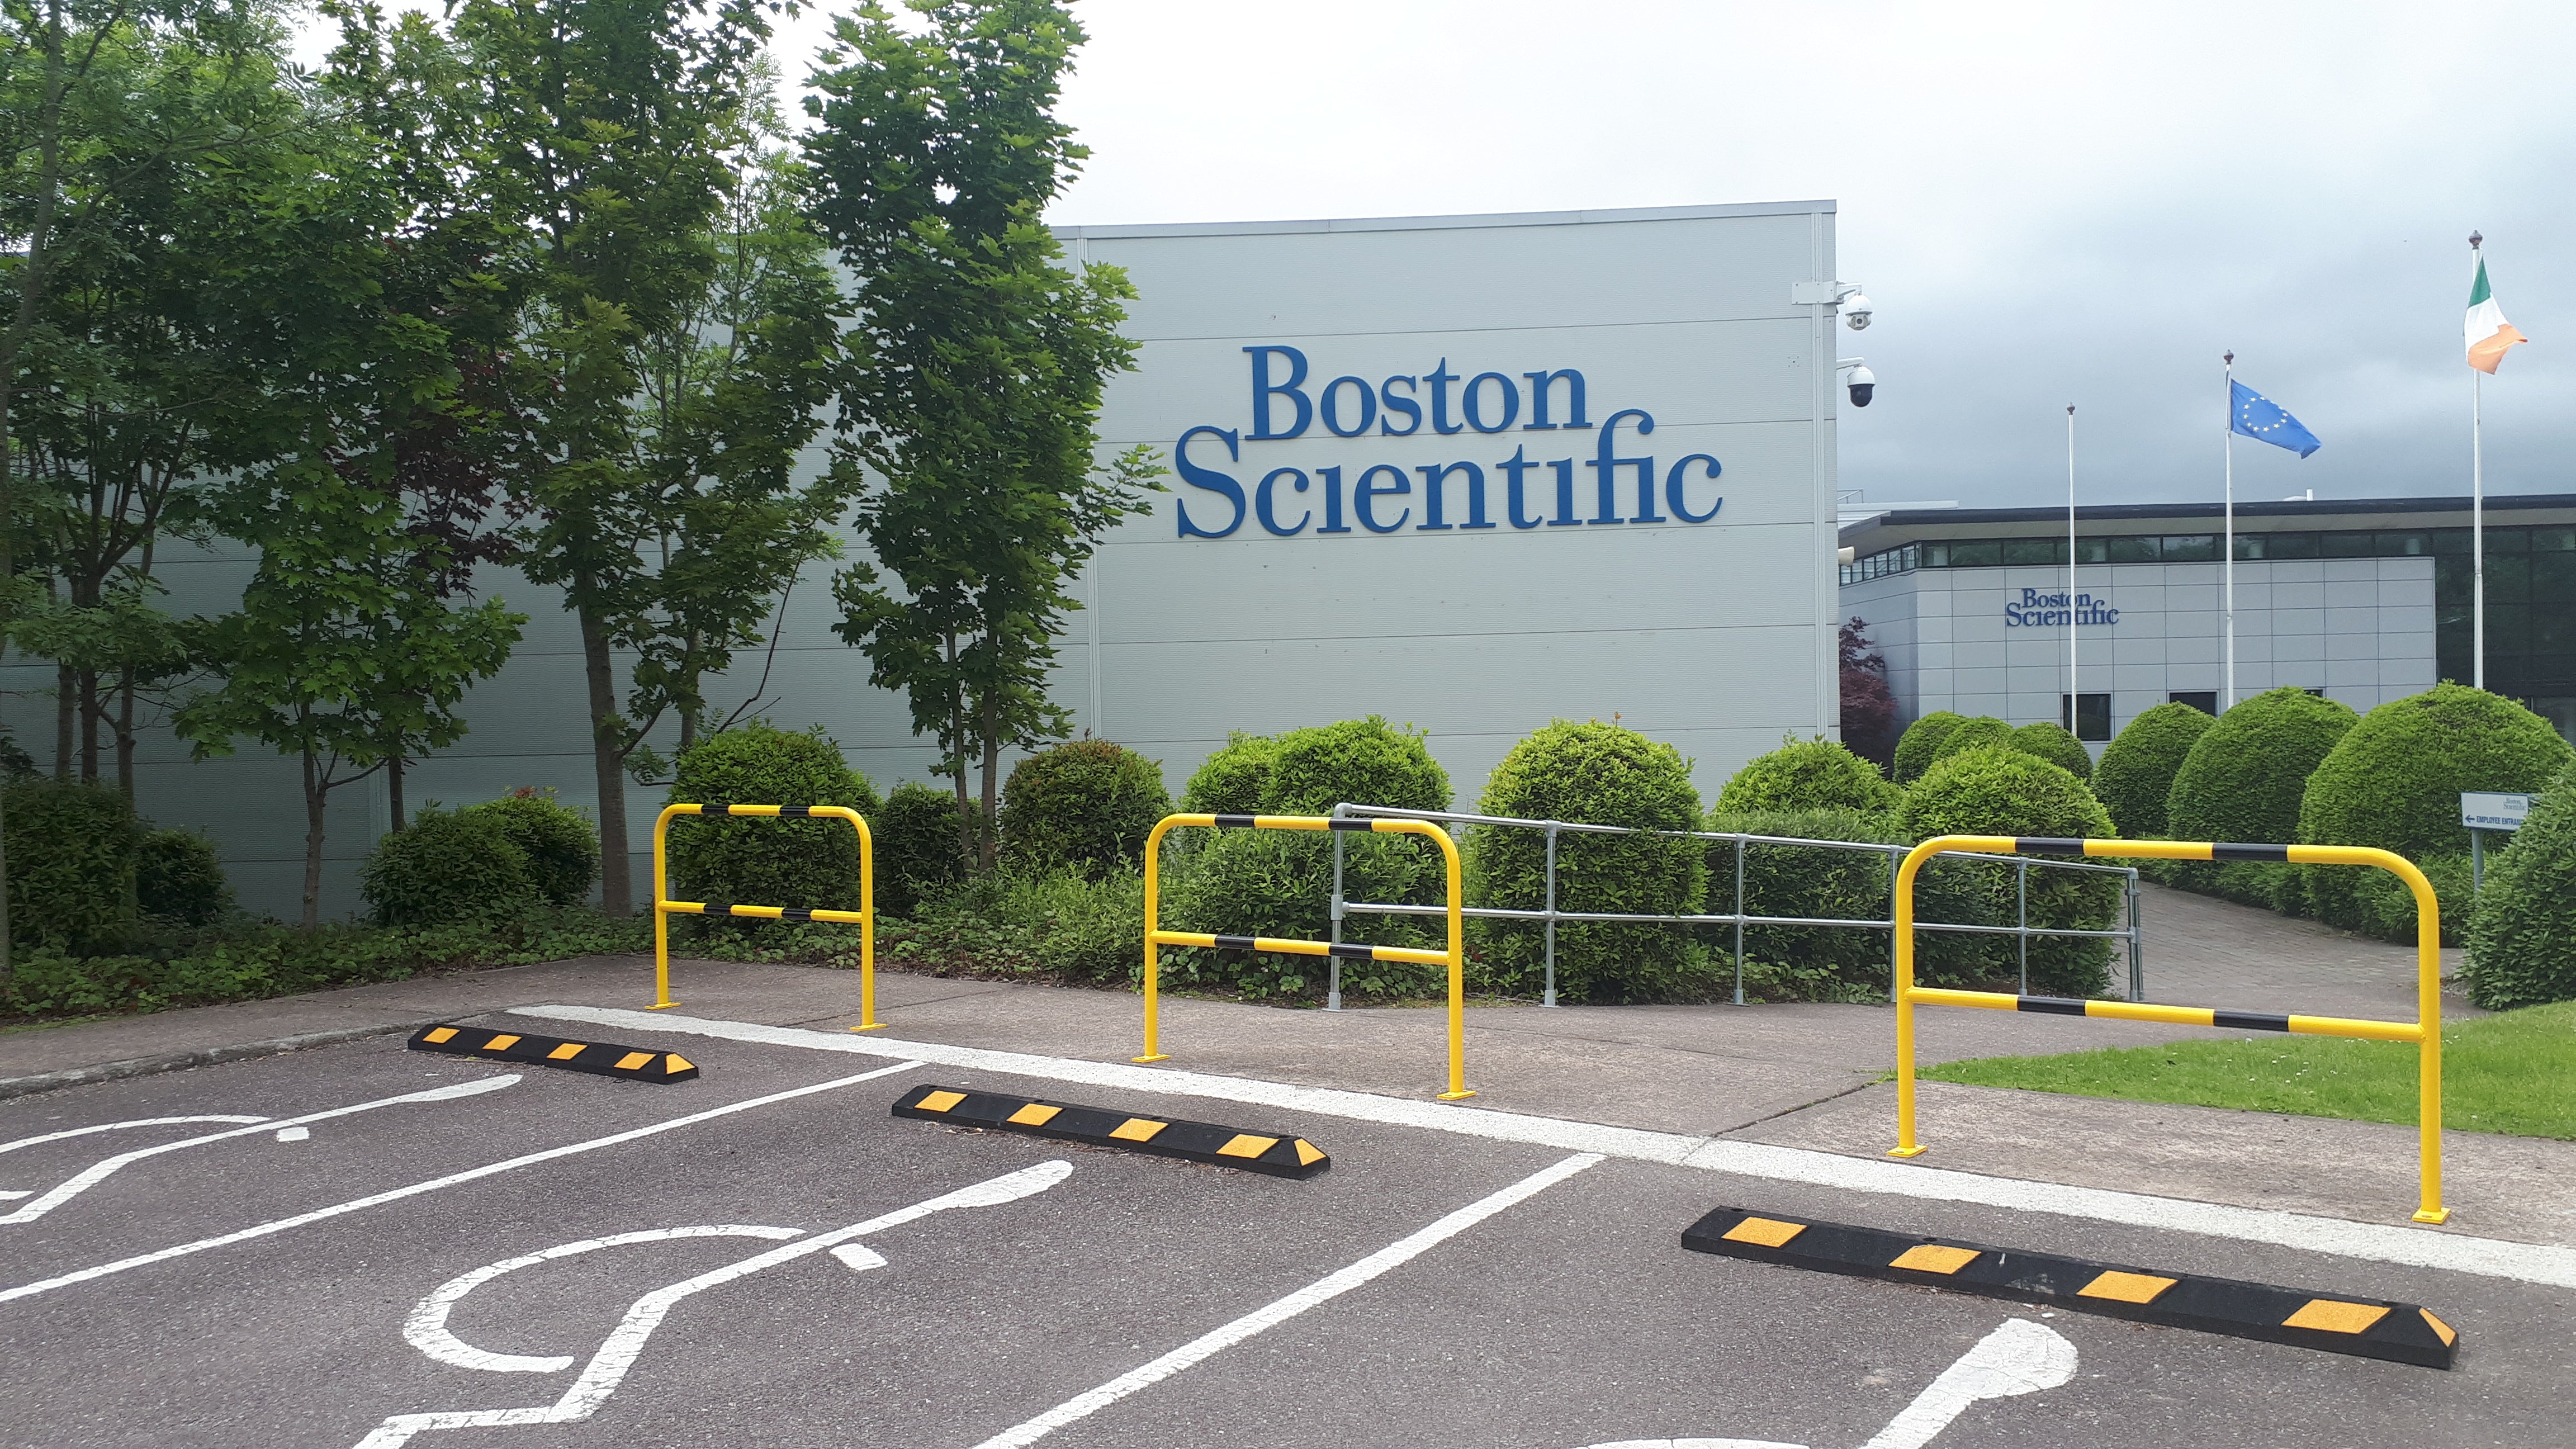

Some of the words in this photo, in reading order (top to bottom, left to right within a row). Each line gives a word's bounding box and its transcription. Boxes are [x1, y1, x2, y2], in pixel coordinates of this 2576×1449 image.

[1242, 345, 1593, 441] Boston
[1175, 409, 1723, 538] Scientific
[2021, 588, 2092, 608] Boston
[2006, 600, 2119, 627] Scientific
[2476, 816, 2501, 824] EMPLOYEE
